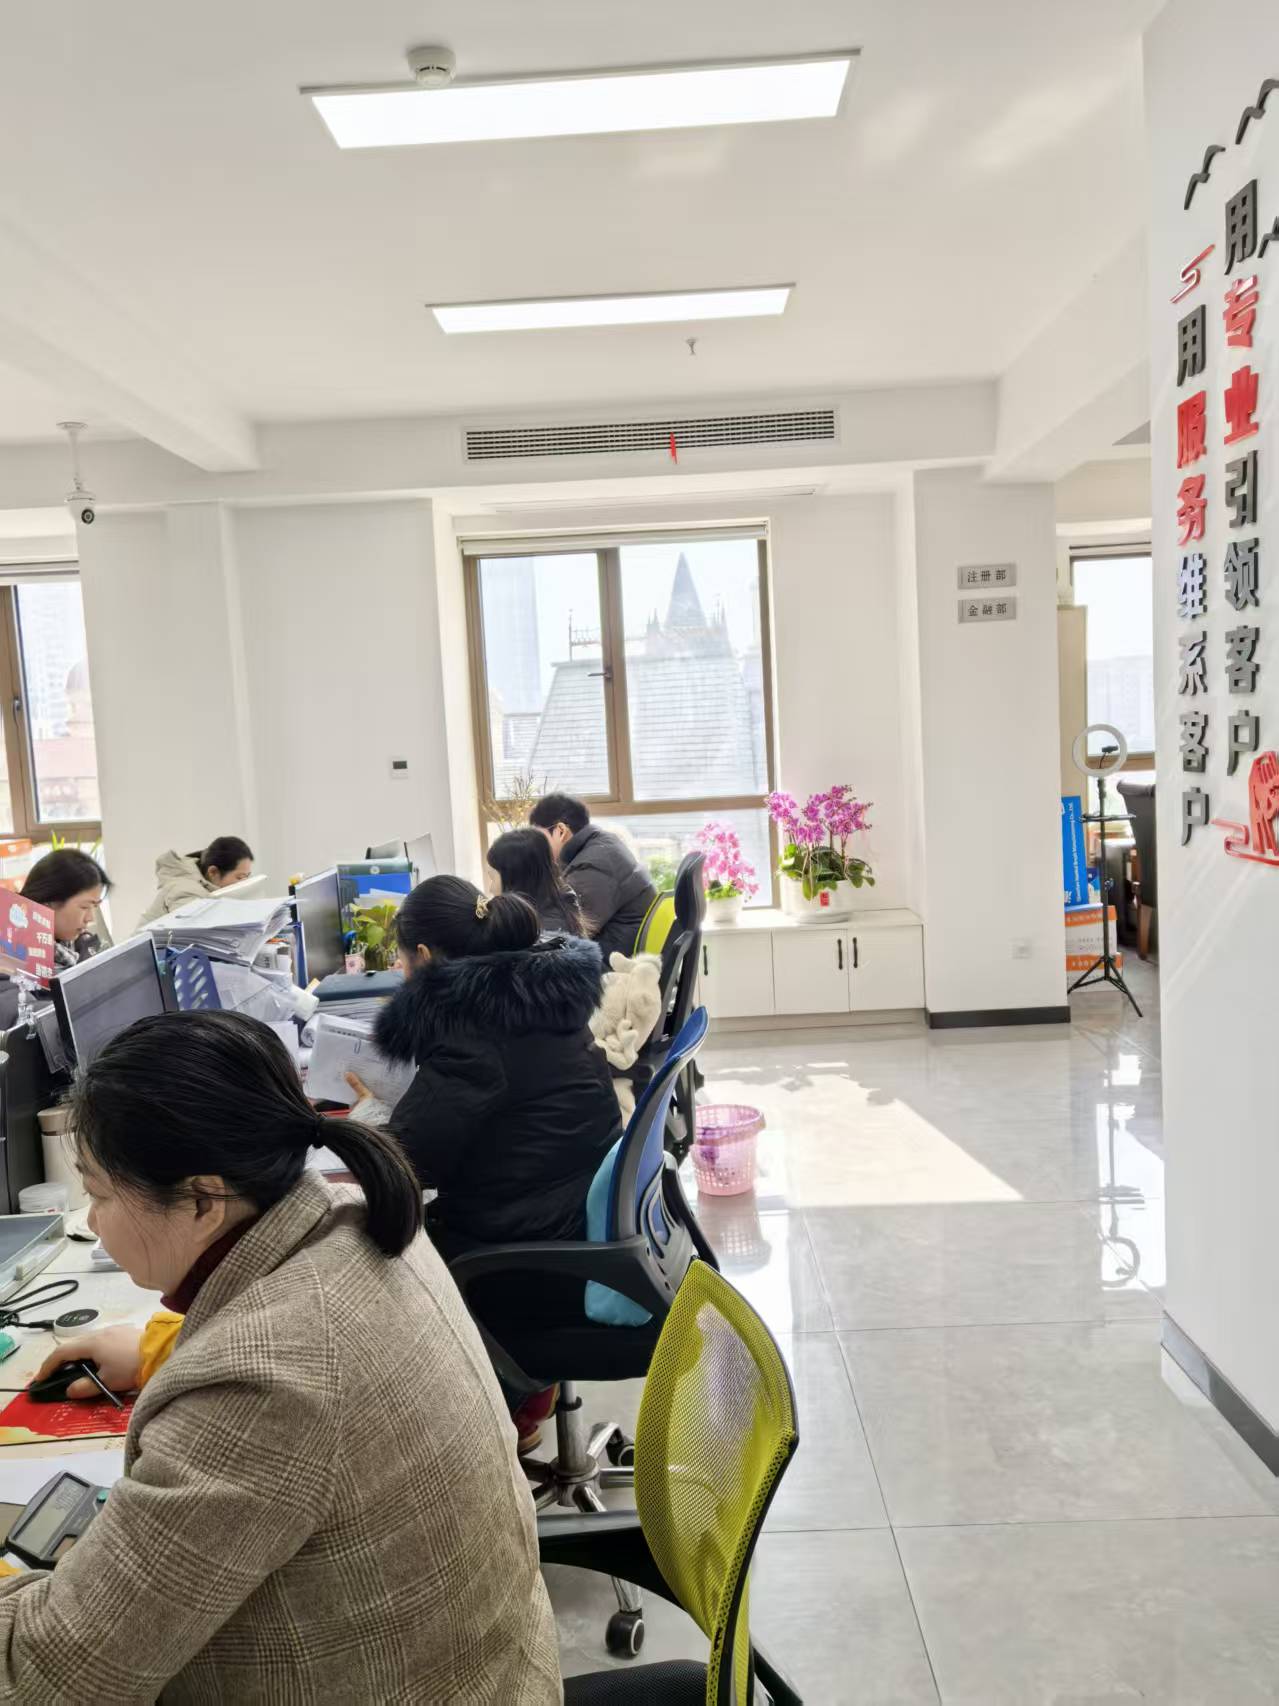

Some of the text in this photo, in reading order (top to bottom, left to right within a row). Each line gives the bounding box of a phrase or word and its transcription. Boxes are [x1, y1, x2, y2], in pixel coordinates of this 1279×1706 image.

[1176, 304, 1210, 847] 用服务维系客户
[1223, 179, 1260, 776] 用专业引领客户
